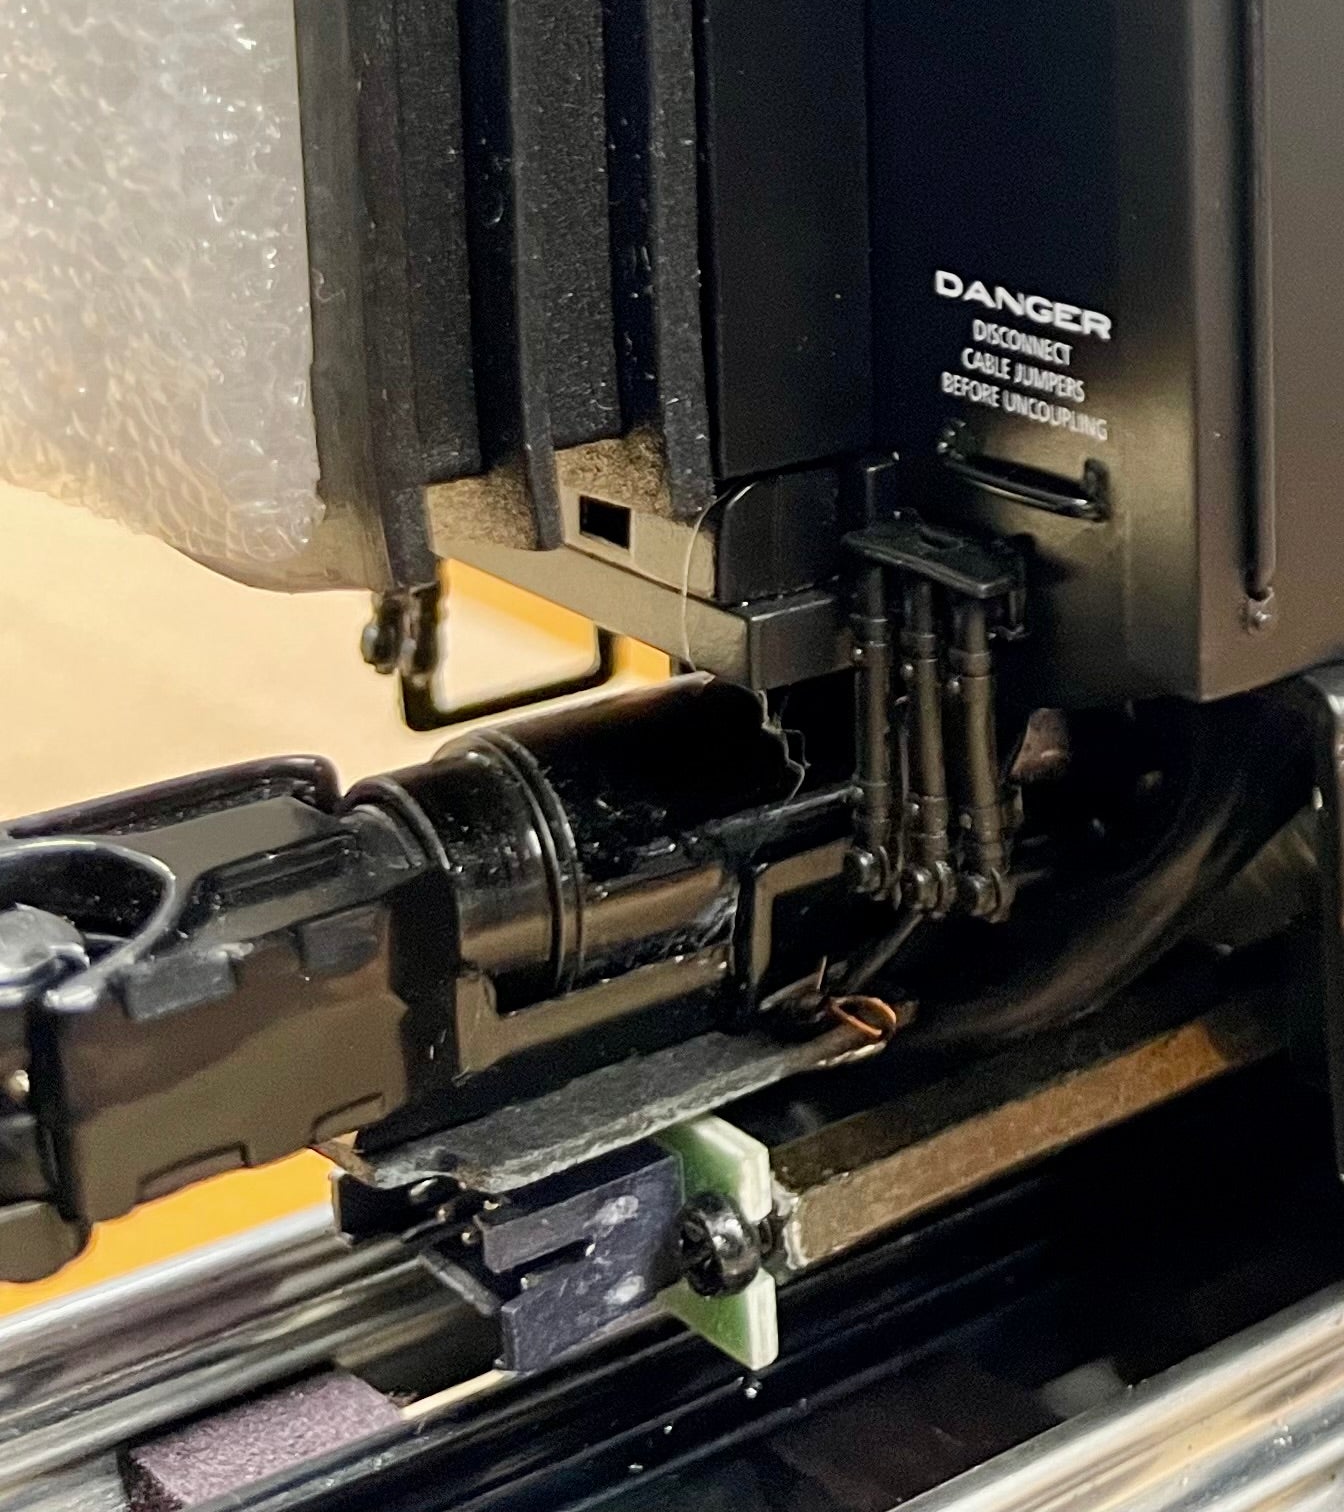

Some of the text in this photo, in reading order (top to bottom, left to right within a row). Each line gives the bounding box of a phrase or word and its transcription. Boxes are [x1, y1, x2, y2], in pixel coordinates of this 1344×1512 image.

[935, 269, 1112, 340] DANGER
[972, 318, 1073, 366] DISCONNECT
[941, 371, 1108, 441] BEFORE UNCOUPLING
[961, 347, 1085, 403] CABLE JUMPERS
